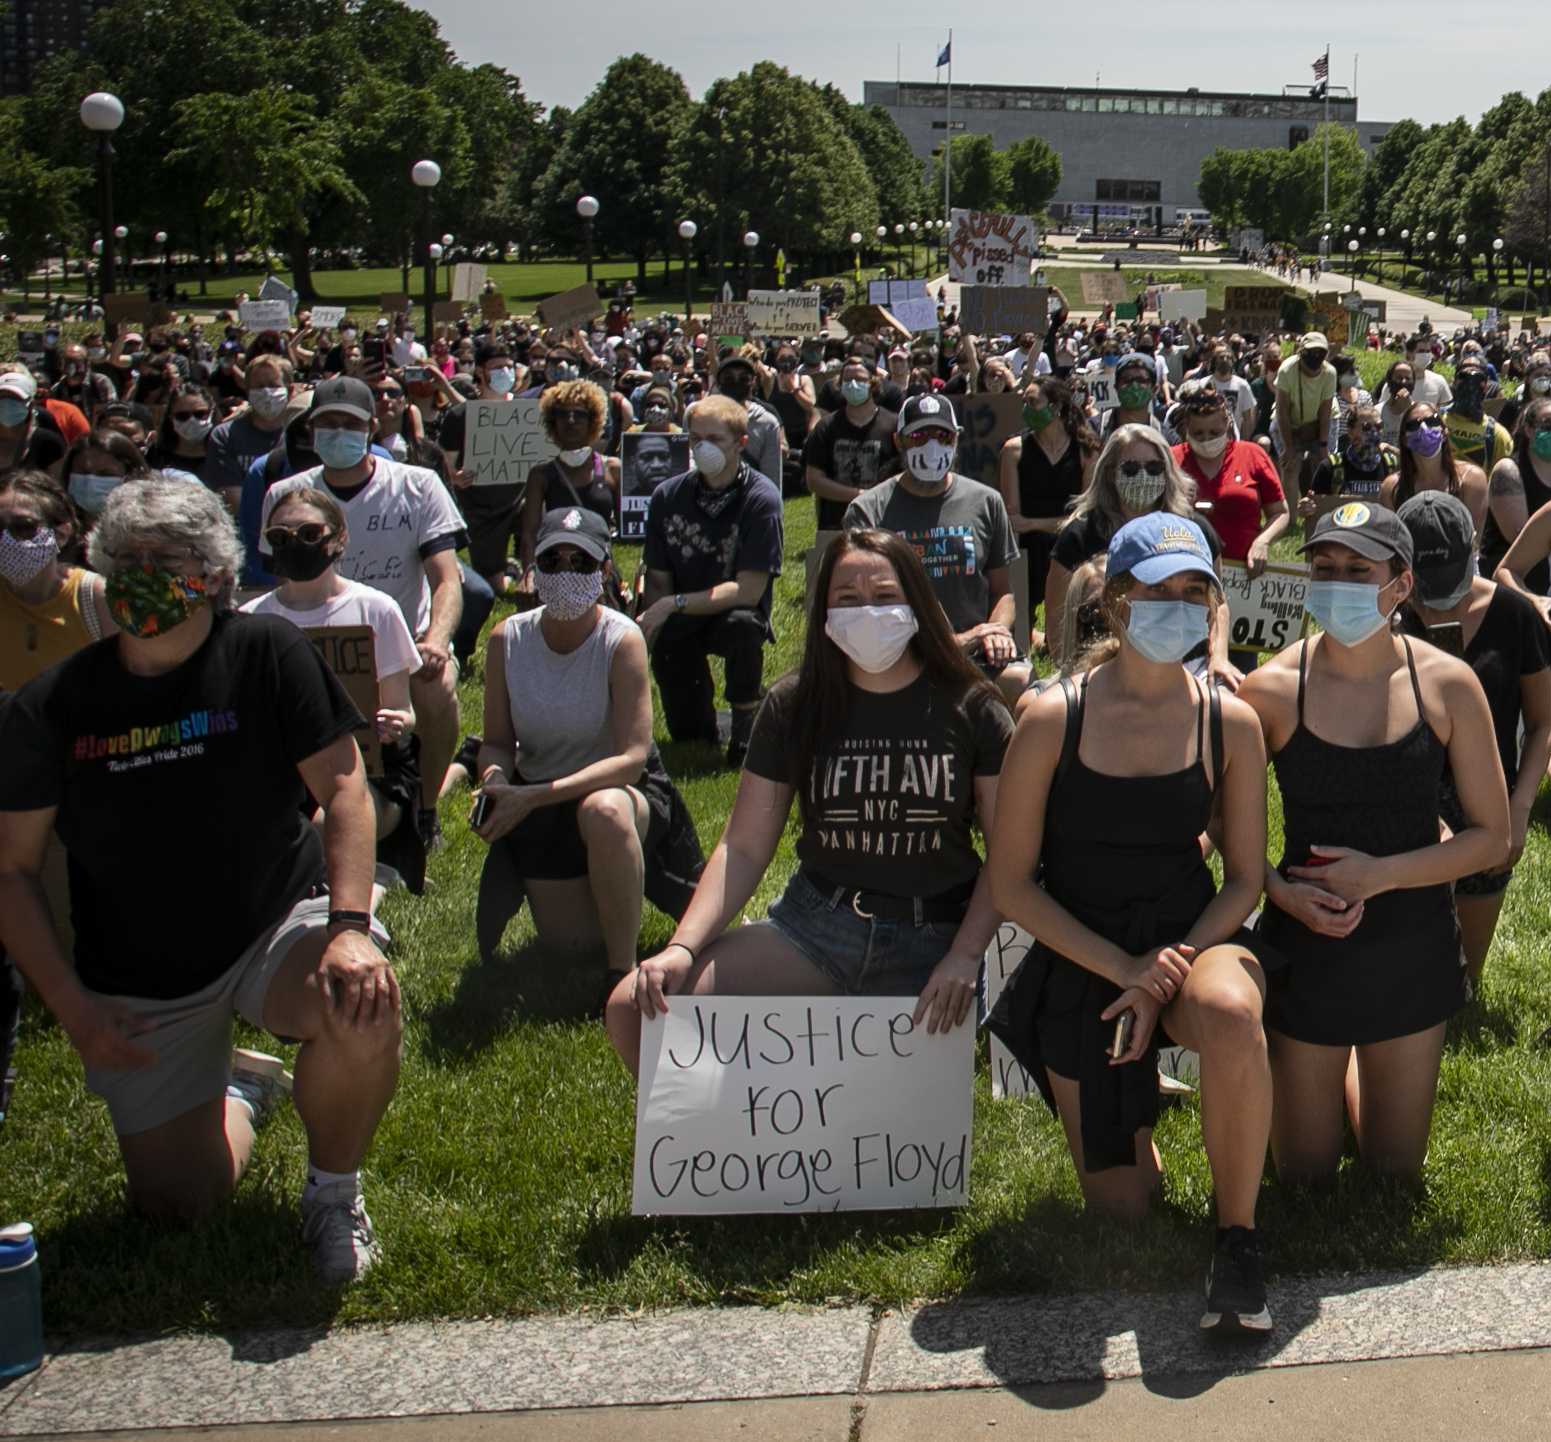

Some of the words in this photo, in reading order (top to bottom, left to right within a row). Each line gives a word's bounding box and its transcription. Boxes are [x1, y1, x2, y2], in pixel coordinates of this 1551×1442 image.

[478, 406, 546, 428] BLAC
[1260, 580, 1306, 601] BLACK
[1232, 616, 1289, 650] STO
[179, 742, 204, 757] 2016
[900, 753, 955, 802] AVE
[864, 799, 900, 821] NYC
[668, 1005, 915, 1069] Justice
[742, 1084, 844, 1137] for
[649, 1135, 843, 1207] George
[853, 1133, 968, 1197] Floyd
